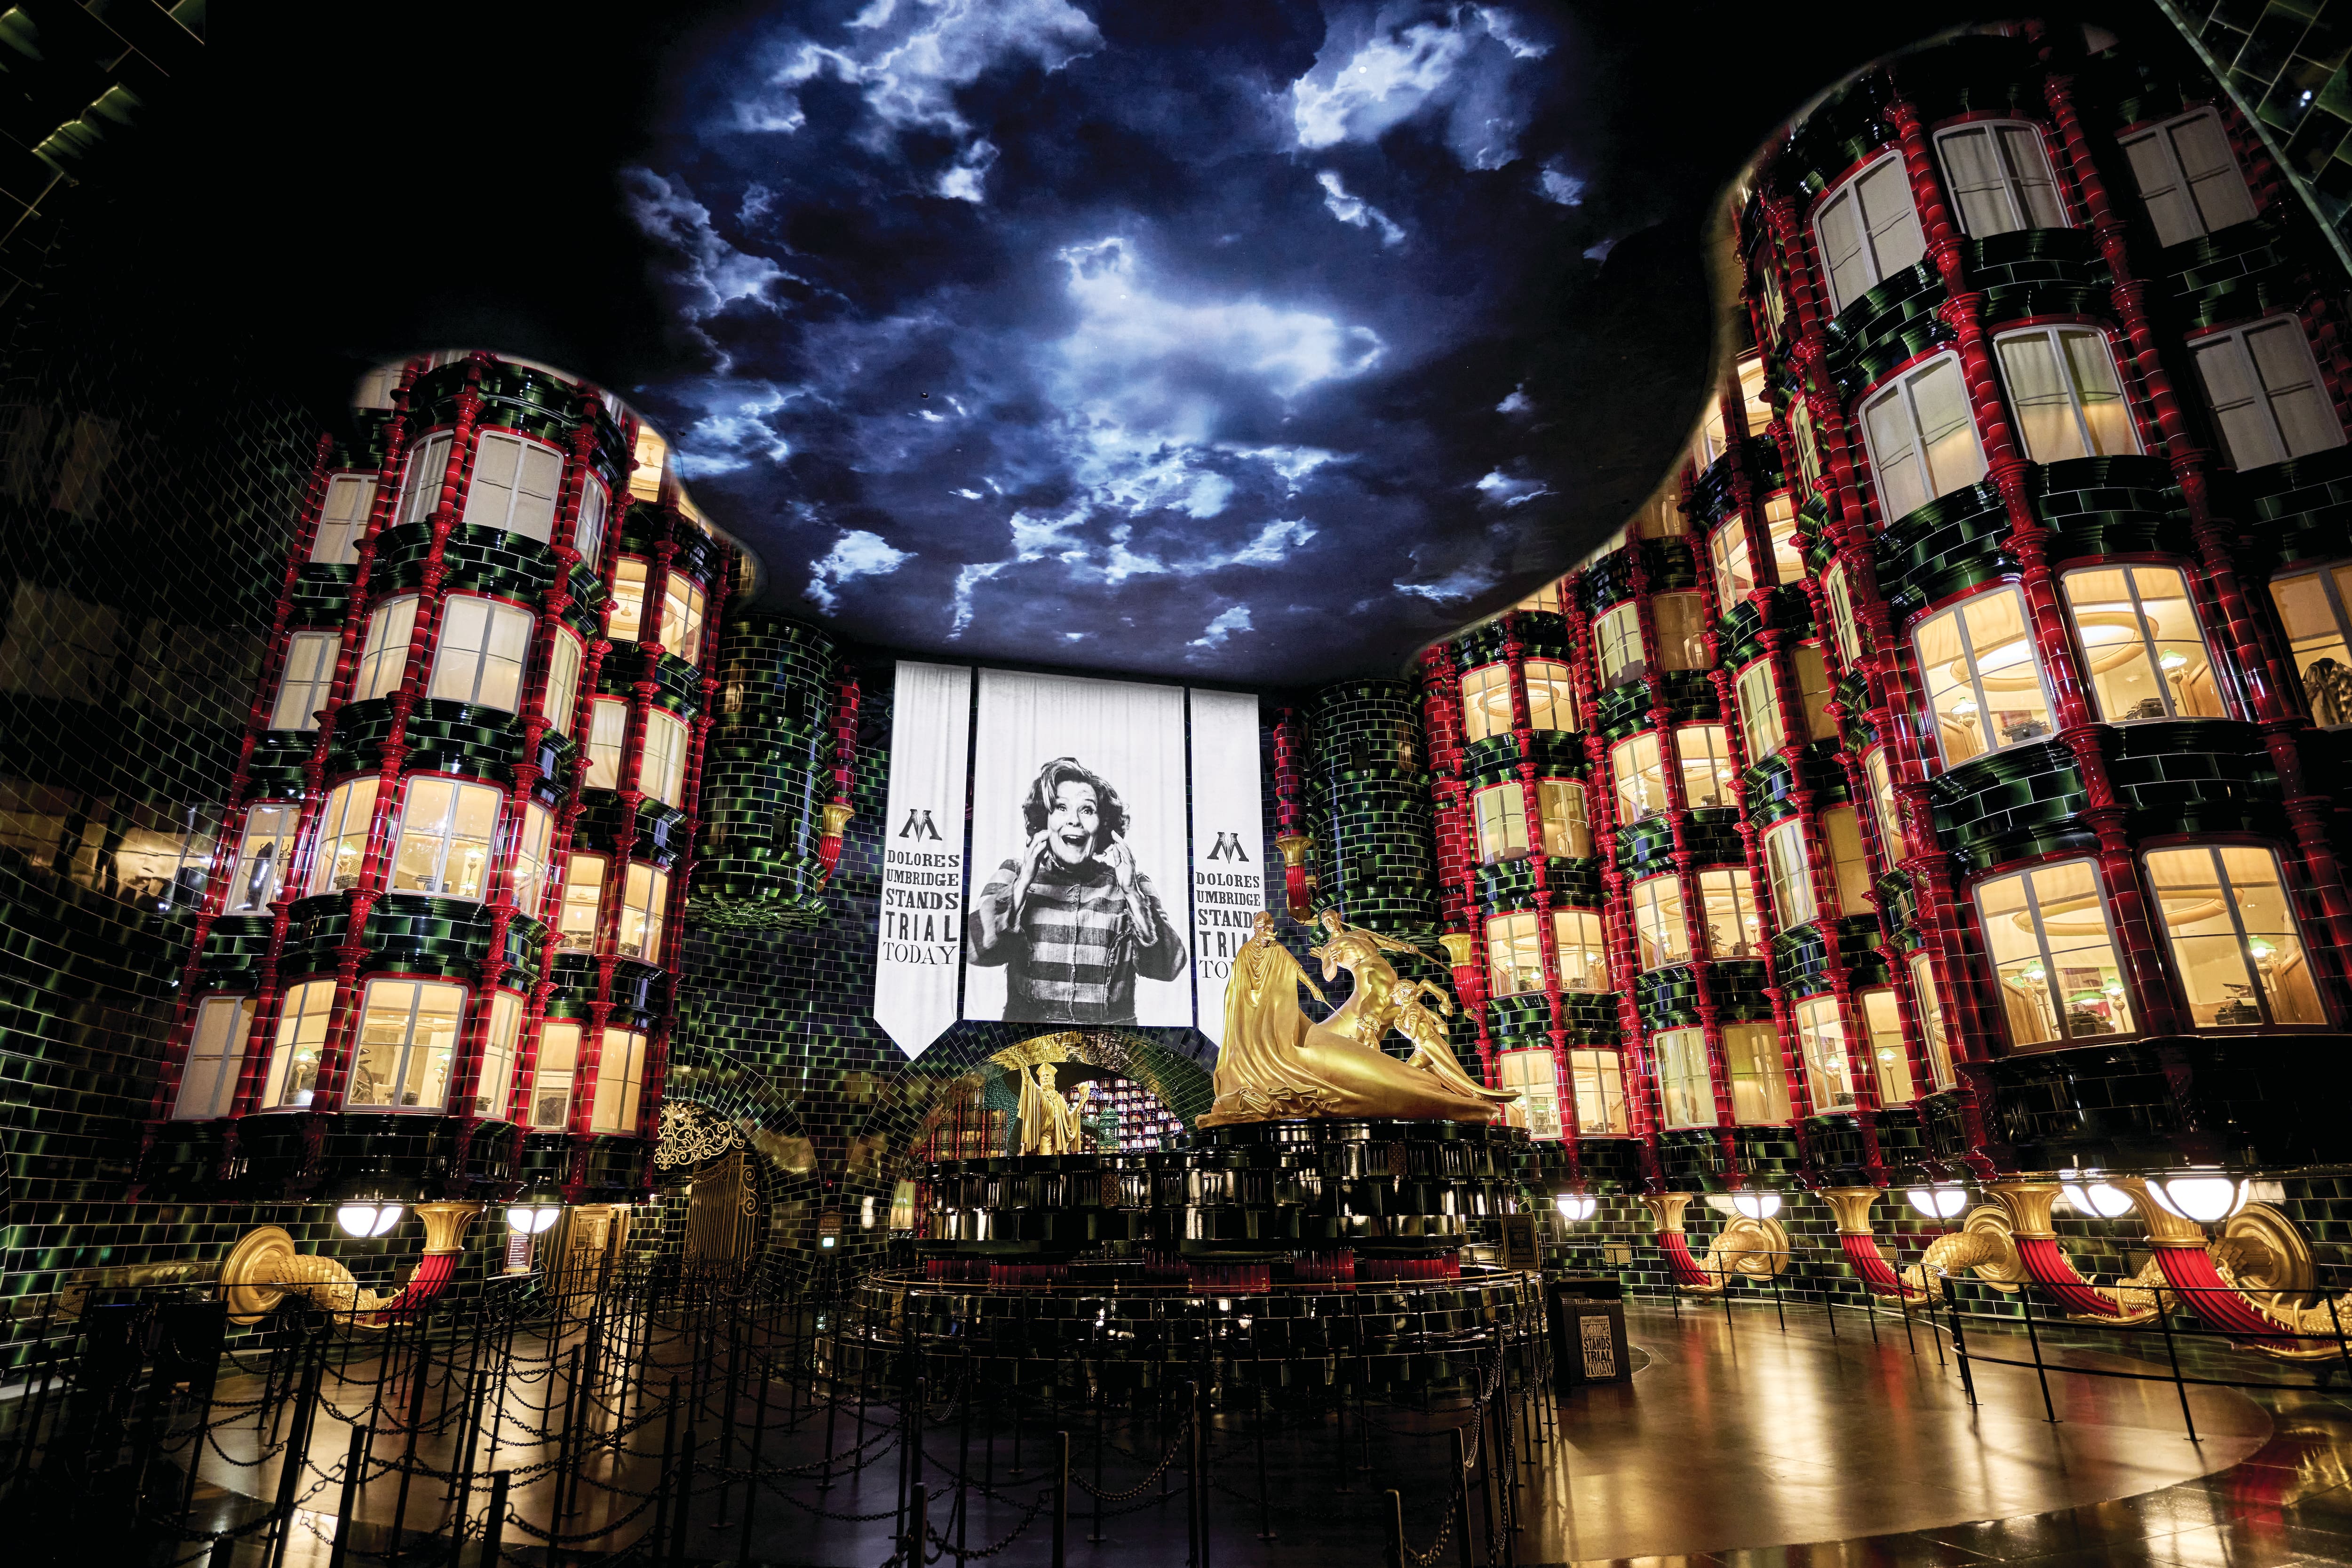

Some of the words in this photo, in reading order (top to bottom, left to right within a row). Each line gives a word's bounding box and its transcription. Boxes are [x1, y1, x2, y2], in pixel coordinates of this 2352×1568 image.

[887, 850, 960, 868] DOLORES
[886, 868, 959, 886] UMBRIDGE
[1195, 872, 1260, 888] DOLORES
[886, 888, 959, 910] STANDS
[1196, 890, 1261, 907] UMBRIDGE
[885, 911, 958, 942] TRIAL
[1198, 908, 1257, 929] STAND
[882, 941, 959, 965] TODAY
[1582, 1324, 1609, 1337] UMBRIDGE
[1584, 1337, 1611, 1351] STANDS
[1585, 1350, 1612, 1362] TRIAL
[1587, 1362, 1613, 1374] TODAY
